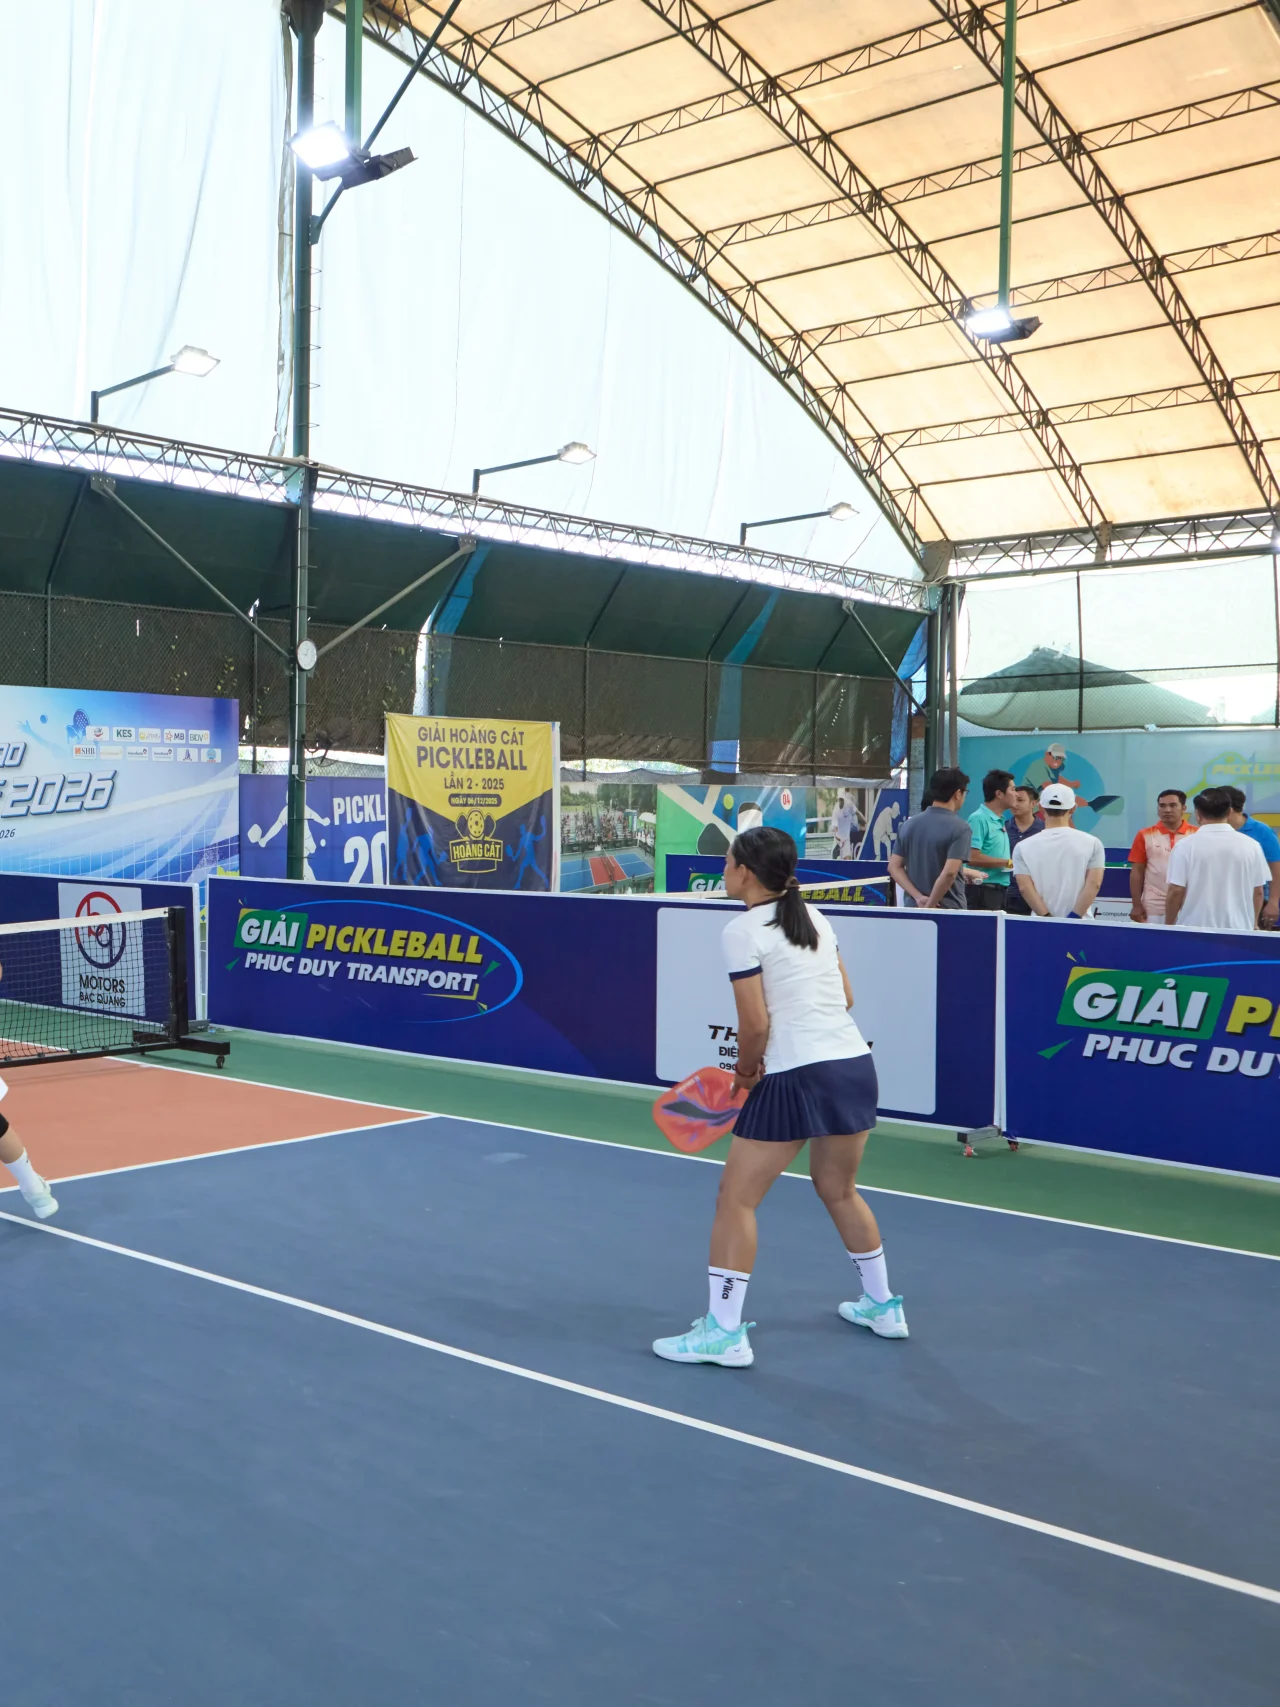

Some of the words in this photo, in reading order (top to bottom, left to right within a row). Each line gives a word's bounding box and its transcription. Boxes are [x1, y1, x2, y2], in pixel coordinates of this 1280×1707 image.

[116, 729, 132, 738] KES
[190, 734, 203, 742] BIDV
[418, 722, 445, 742] GIẢI
[450, 725, 497, 744] HOÀNG
[501, 727, 524, 746] CÁT
[81, 747, 95, 755] SHB
[417, 745, 527, 770] PICKLEBALL
[444, 771, 463, 789] LẦN
[467, 778, 473, 789] 2
[482, 778, 504, 790] 2025
[1, 769, 117, 819] 2026
[782, 793, 791, 805] 04
[333, 794, 385, 825] PICKL
[453, 842, 483, 859] HOÀNG
[484, 842, 501, 857] CÁT
[241, 914, 300, 948] GIẢI
[306, 924, 483, 963] PICKLEBALL
[245, 952, 295, 972] PHUC
[298, 957, 341, 978] DUY
[347, 962, 477, 992] TRANSPORT
[80, 975, 125, 994] MOTORS
[1073, 978, 1208, 1030] GIẢI
[1083, 1033, 1197, 1069] PHUC
[1206, 1047, 1280, 1078] DU
